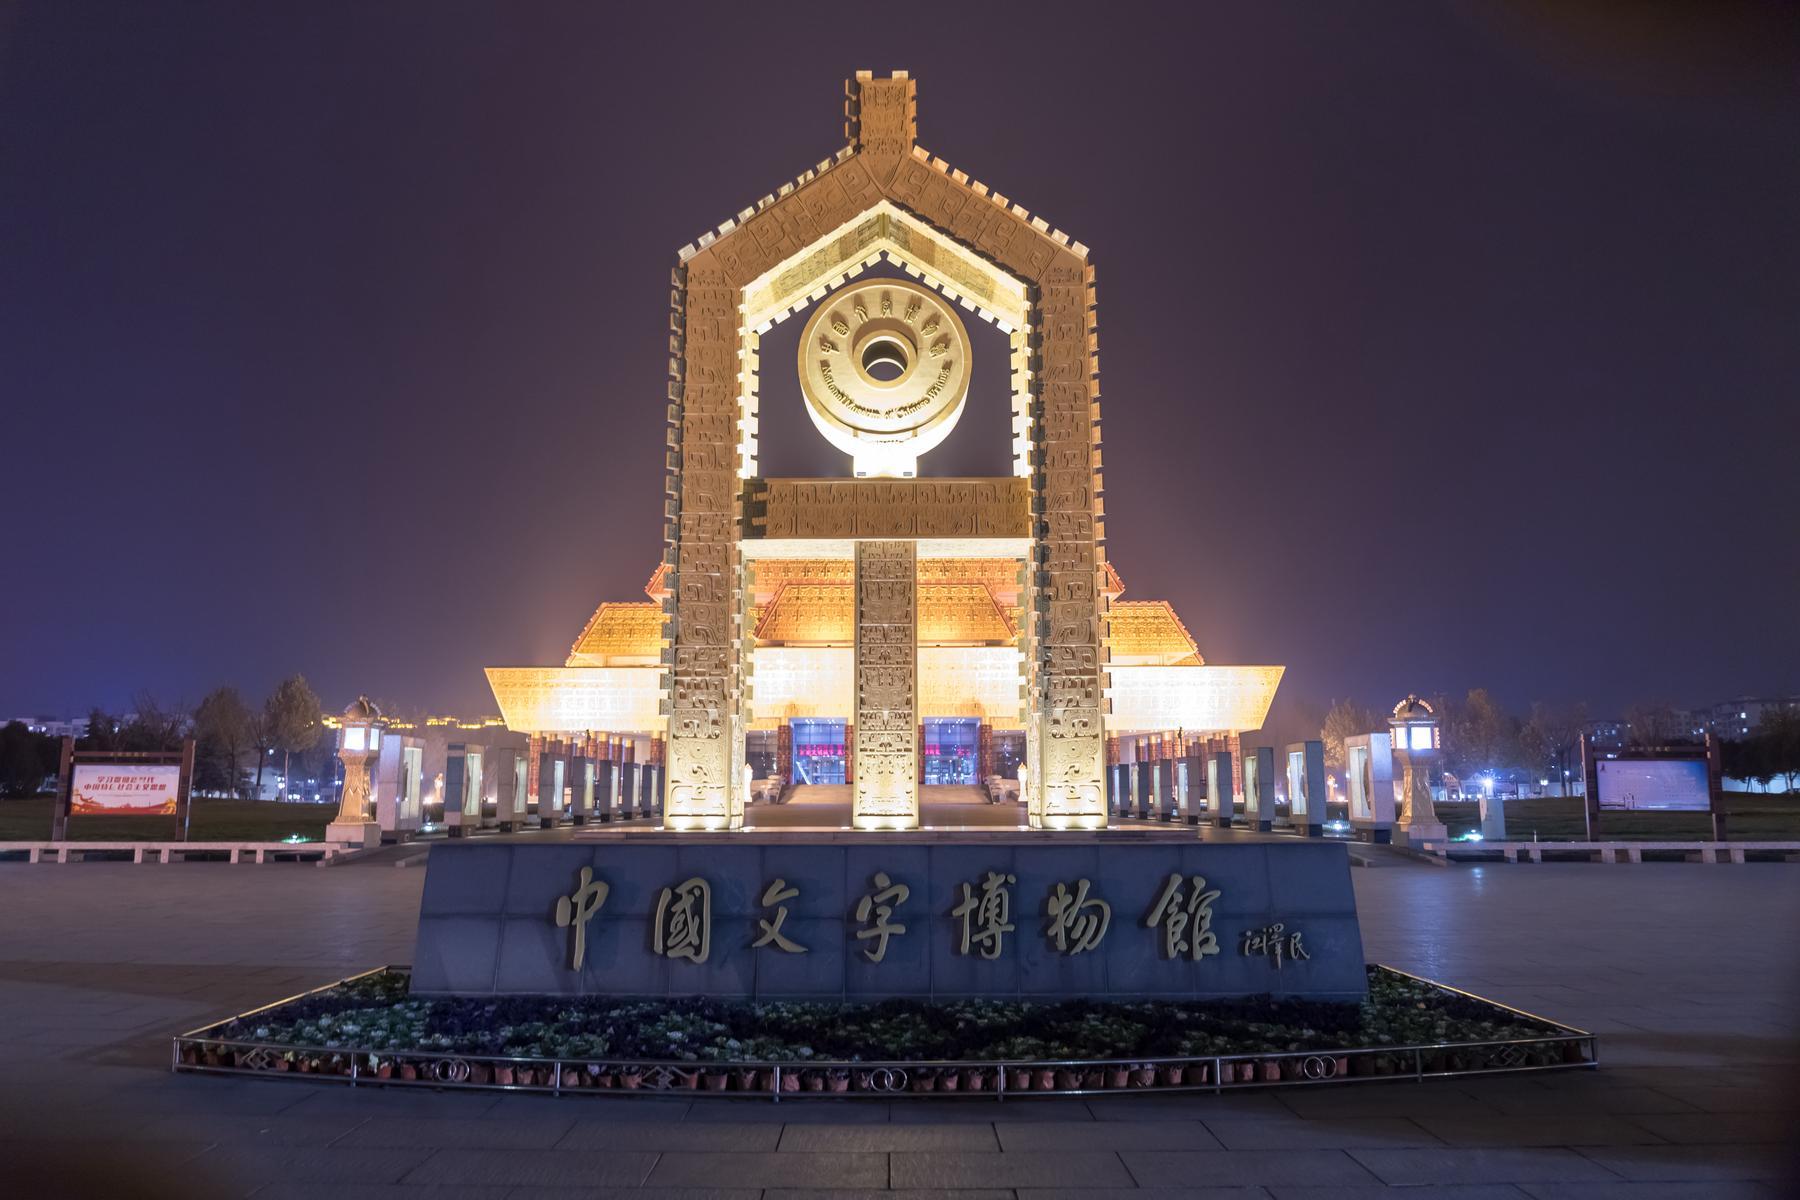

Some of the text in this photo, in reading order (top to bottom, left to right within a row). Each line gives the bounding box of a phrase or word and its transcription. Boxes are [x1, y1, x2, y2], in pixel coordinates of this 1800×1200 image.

[556, 866, 1221, 972] 中國文字博物館
